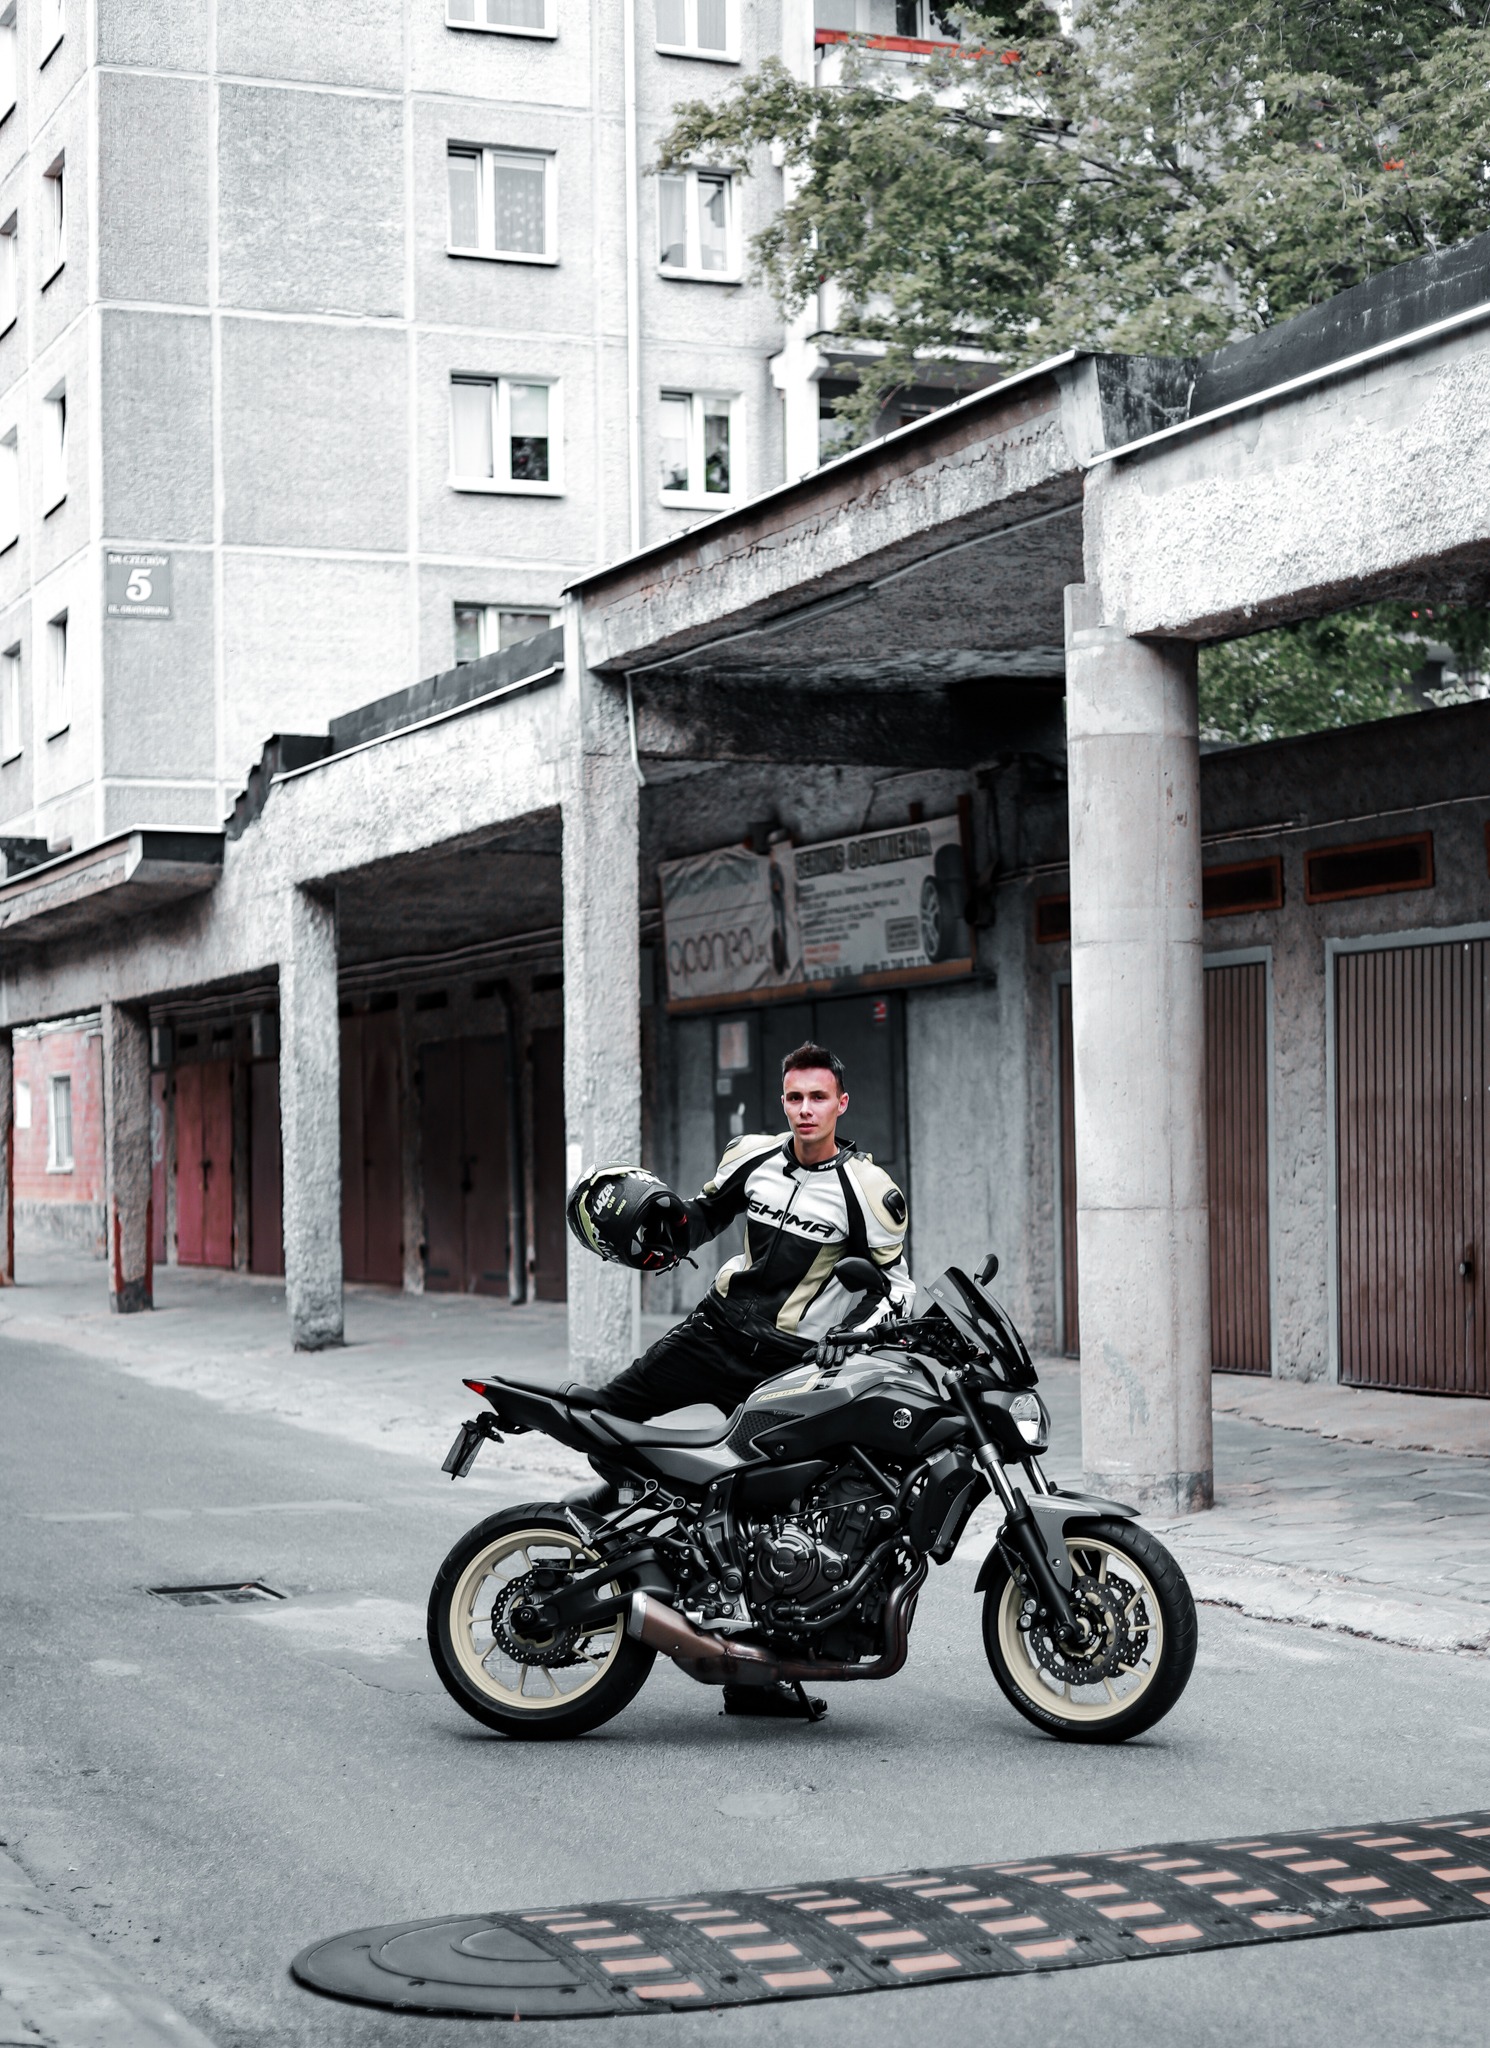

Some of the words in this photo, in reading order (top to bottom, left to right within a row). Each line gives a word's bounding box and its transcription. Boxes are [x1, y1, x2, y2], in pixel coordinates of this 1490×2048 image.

[125, 568, 153, 602] 5
[593, 1183, 616, 1216] LAZER
[748, 1200, 836, 1238] SHIMA
